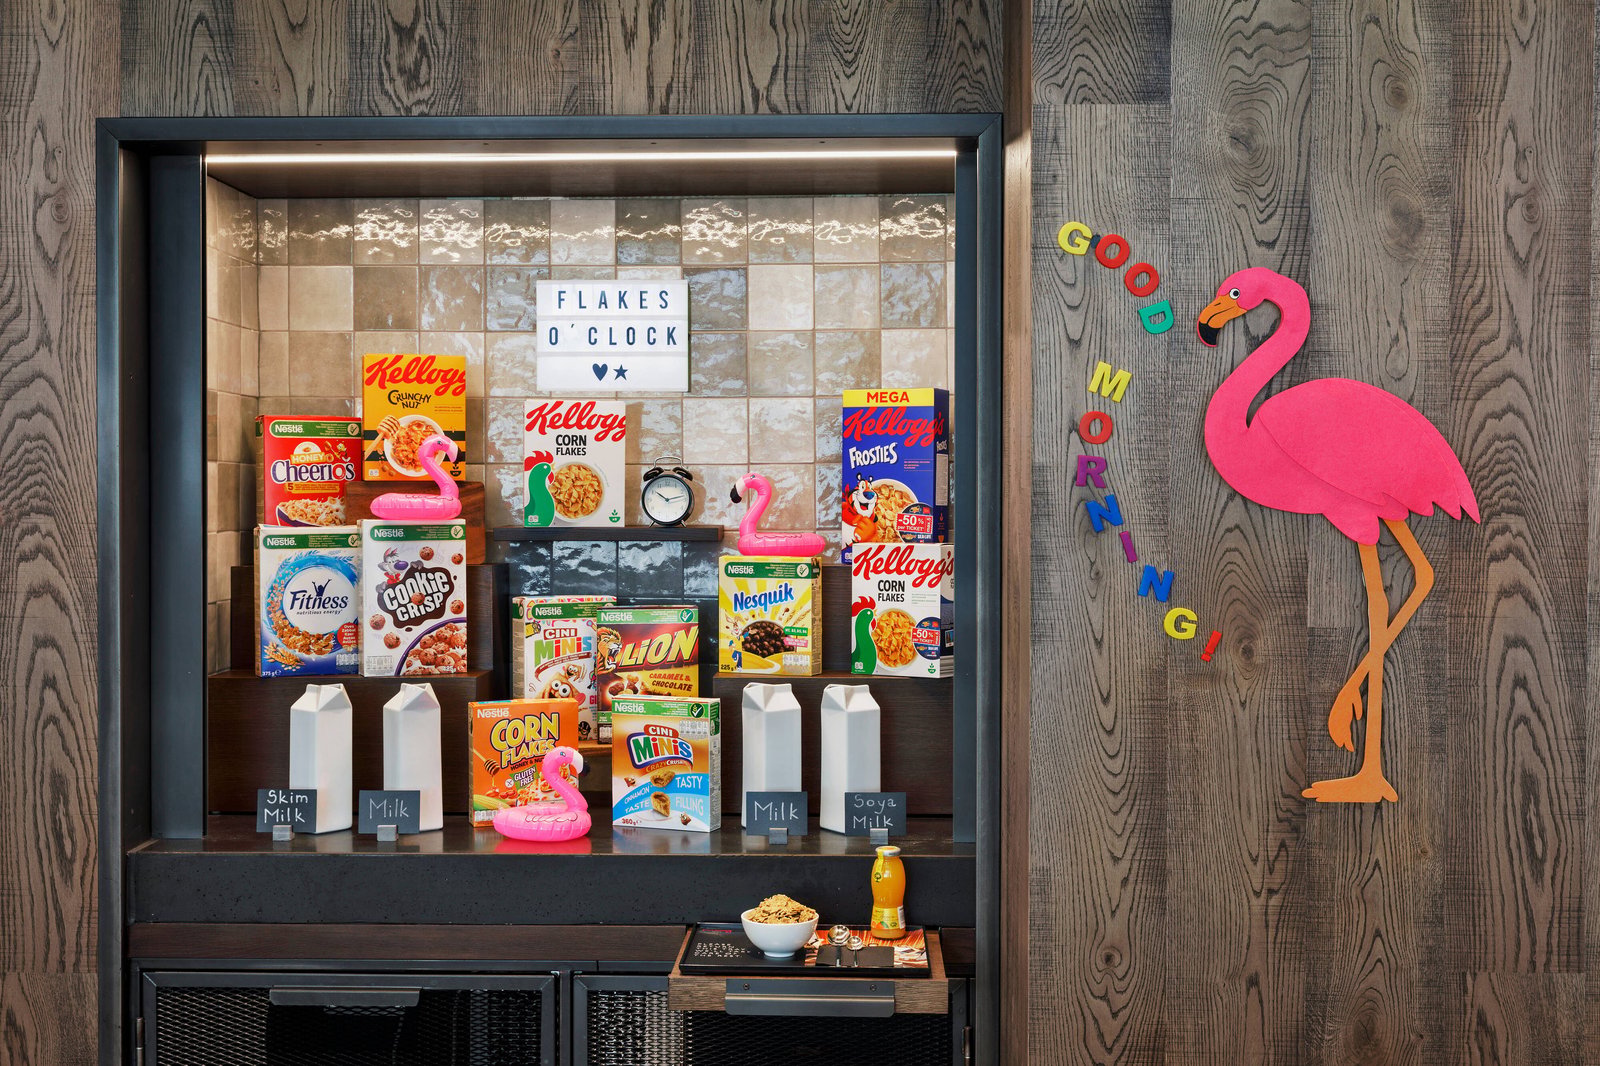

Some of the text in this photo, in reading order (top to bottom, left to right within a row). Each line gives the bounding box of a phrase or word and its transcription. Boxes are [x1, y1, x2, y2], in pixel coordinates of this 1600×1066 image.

[1058, 221, 1174, 334] GOOD
[558, 290, 669, 309] FLAKES
[388, 390, 432, 405] CRUNCHY
[866, 391, 910, 403] MEGA
[402, 401, 421, 409] NUT
[555, 434, 587, 446] CORN
[292, 453, 325, 464] HONEY
[555, 447, 587, 456] FLAKES
[849, 442, 898, 469] FROSTIES
[272, 460, 355, 484] Cheerios
[1076, 361, 1223, 661] MORNING!
[898, 515, 917, 526] -50
[374, 528, 405, 538] Nestlé
[878, 580, 905, 592] CORN
[289, 590, 349, 611] Fitness
[733, 582, 795, 612] Nesquik
[877, 593, 905, 602] FLAKES
[545, 628, 576, 639] CINI
[649, 673, 684, 682] CARAMEL
[651, 680, 693, 692] CHOCOLATE
[477, 708, 511, 718] Nestlé
[490, 712, 560, 752] CORN
[649, 726, 673, 737] CINI
[501, 739, 556, 769] FLAKES
[514, 766, 536, 781] GLUTEN
[520, 775, 534, 787] FREE
[676, 776, 703, 789] TASTY
[267, 789, 308, 805] Skim
[624, 785, 650, 805] CINNAMON
[369, 798, 409, 819] Milk
[624, 800, 650, 814] TASTE
[675, 796, 704, 816] FILLING
[754, 800, 799, 821] Milk
[854, 794, 897, 815] Soya
[264, 808, 306, 823] Milk
[853, 815, 894, 829] Milk
